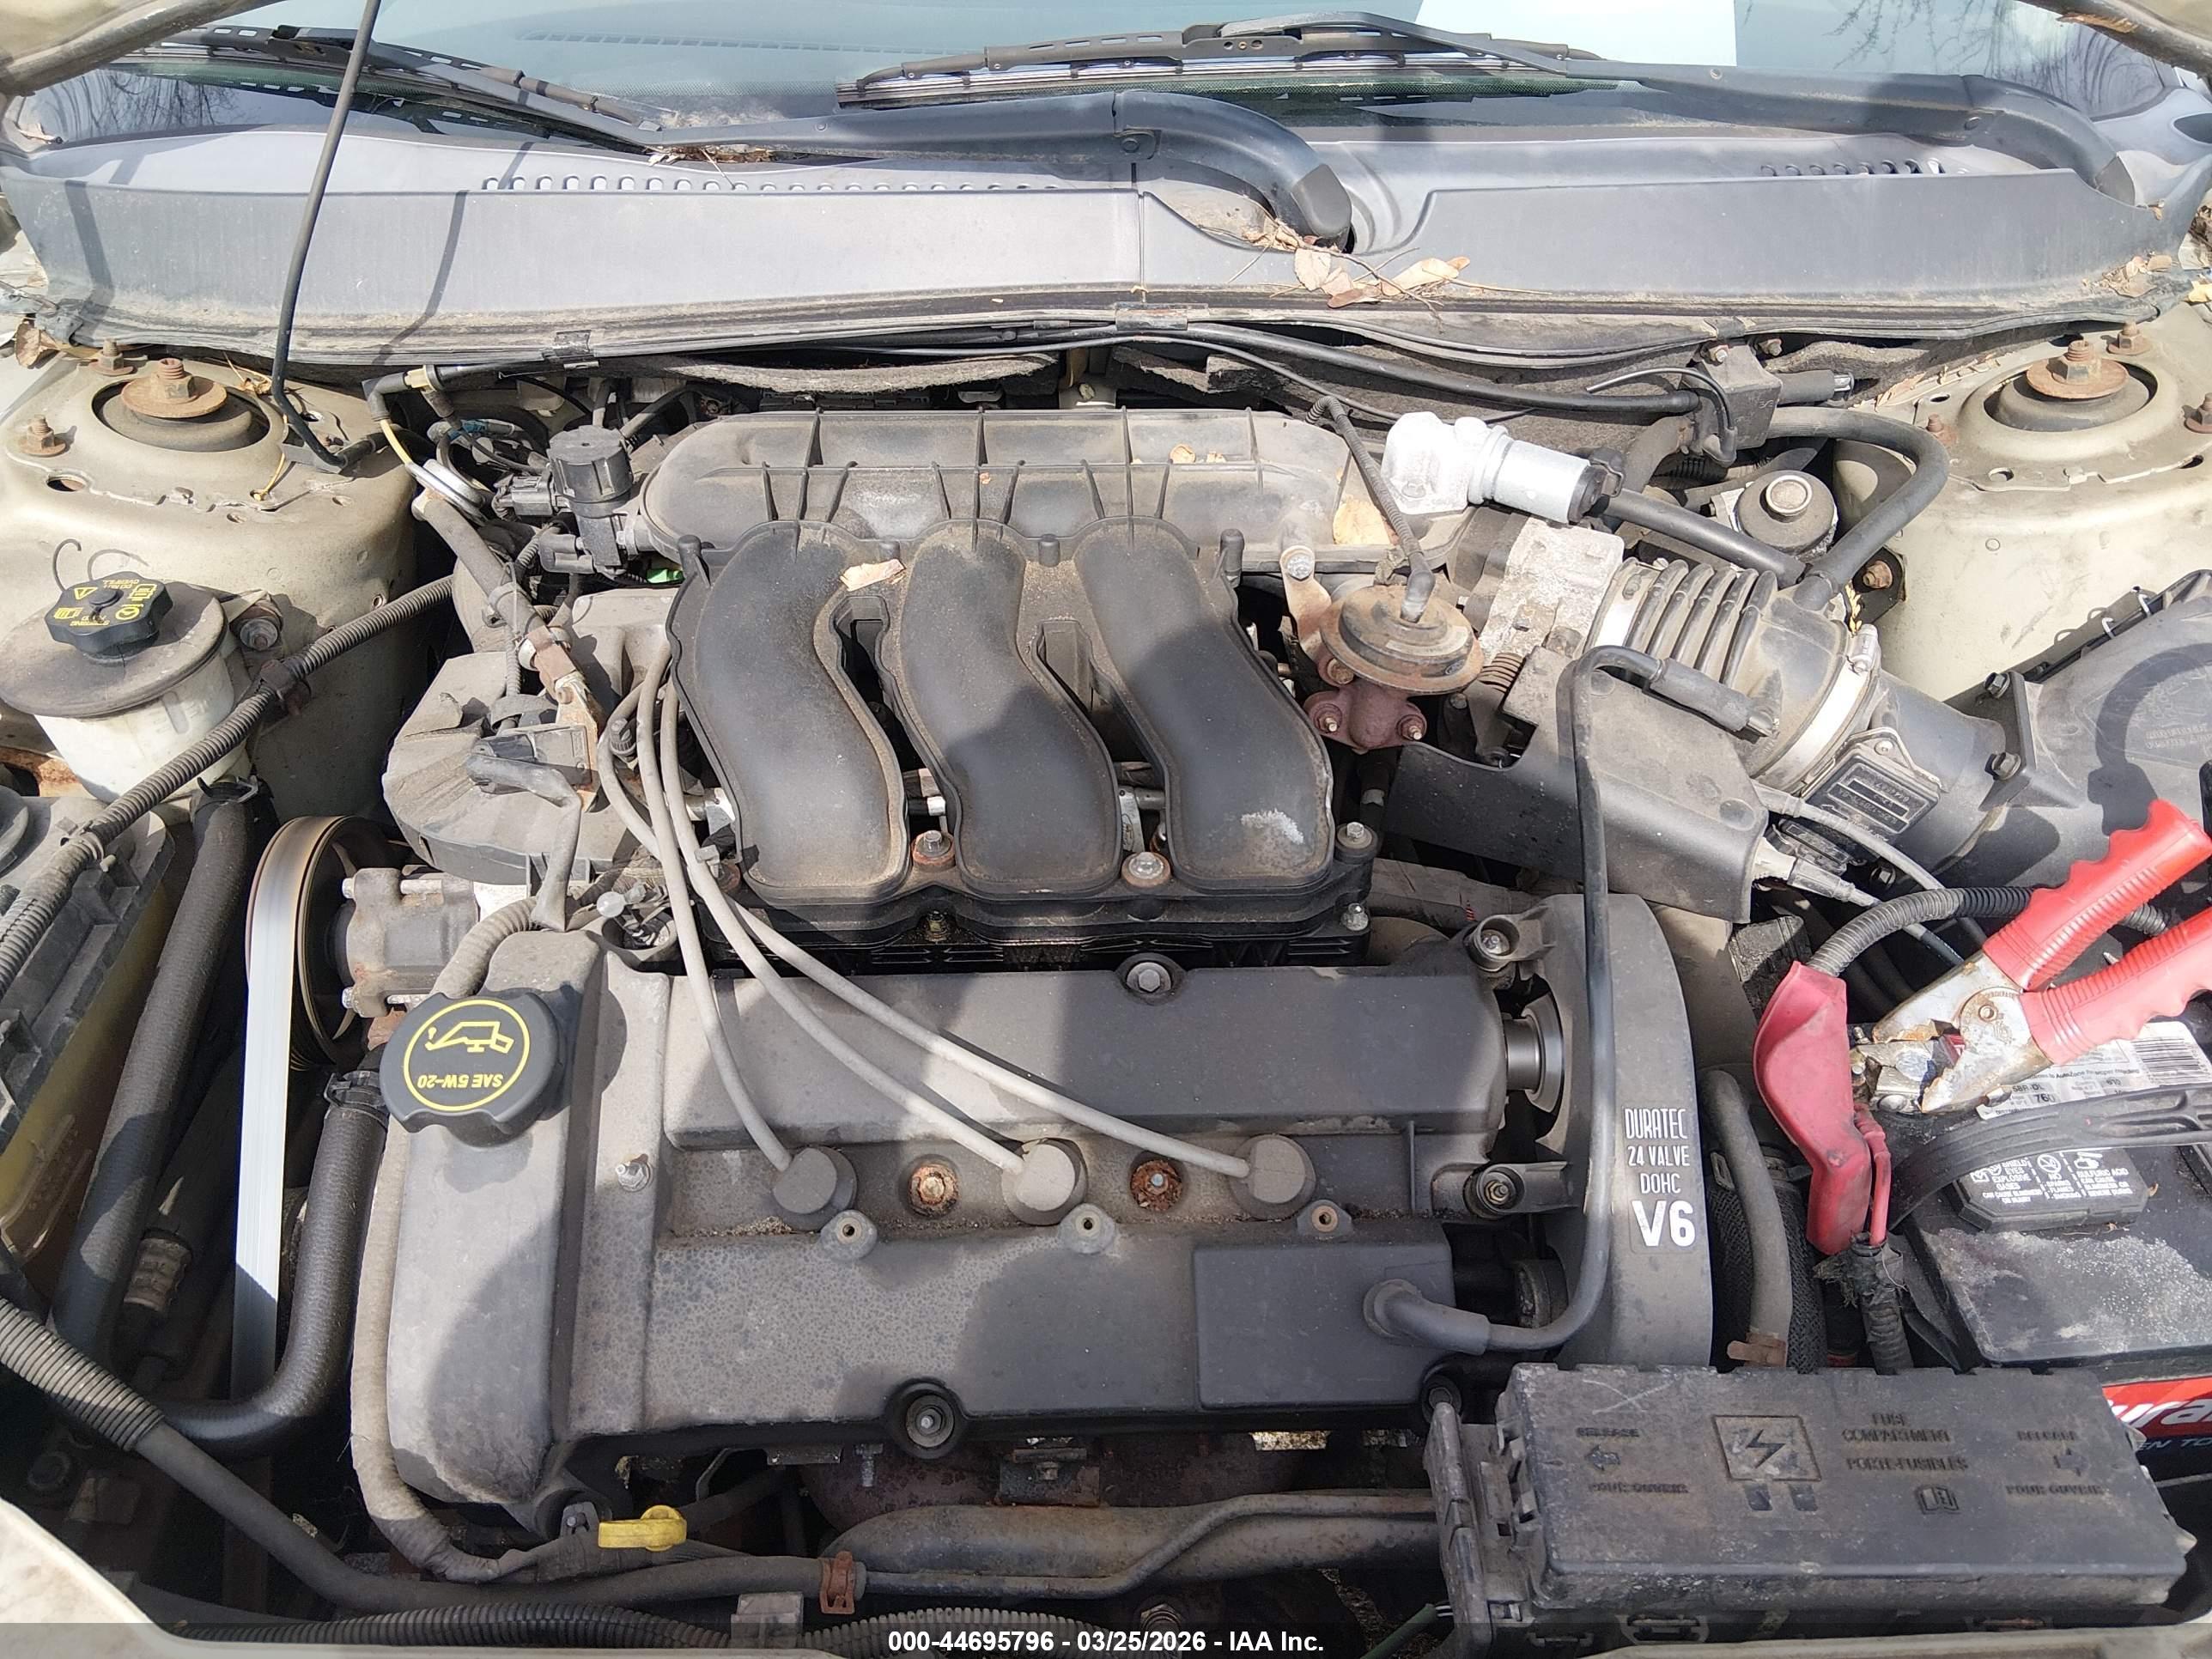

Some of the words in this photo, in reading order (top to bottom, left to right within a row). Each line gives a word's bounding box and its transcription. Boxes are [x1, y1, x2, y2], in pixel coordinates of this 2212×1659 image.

[416, 1073, 469, 1089] 5W-20
[471, 1073, 504, 1088] SAE
[2056, 1070, 2084, 1079] AutoZone
[1625, 1108, 1688, 1139] DURATEC
[1627, 1146, 1645, 1166] 24
[1648, 1145, 1690, 1167] VALVE
[1639, 1172, 1682, 1194] DOHC
[1991, 1173, 2033, 1183] EXPLOSIVE
[1632, 1200, 1696, 1247] V6
[1872, 1413, 1906, 1426] FUSE
[1841, 1428, 1951, 1443] COMPARTMENT
